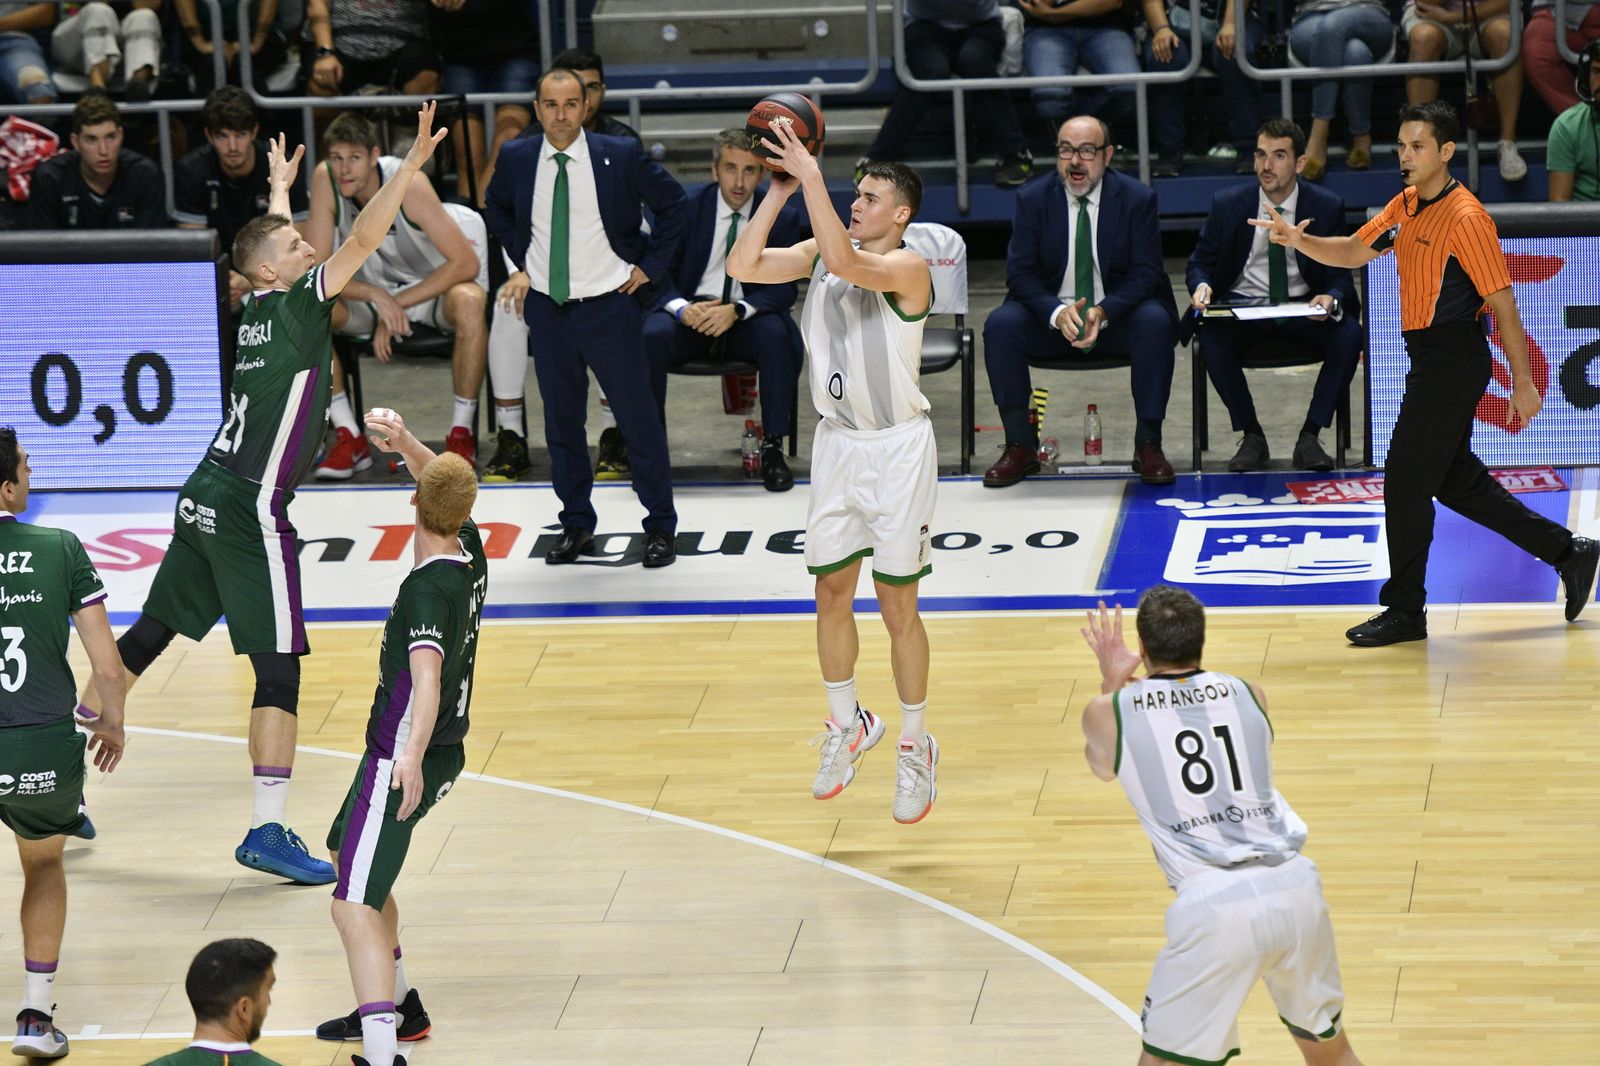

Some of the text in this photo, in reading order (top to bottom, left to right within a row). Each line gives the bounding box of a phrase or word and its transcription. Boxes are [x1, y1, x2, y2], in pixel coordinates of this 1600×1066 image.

[30, 350, 175, 446] 0,0
[828, 372, 843, 400] 0
[409, 622, 444, 640] Andaluc
[0, 626, 28, 693] 3
[1133, 681, 1239, 713] HARANGODY
[1174, 724, 1243, 796] 81
[18, 779, 56, 790] DEL SOL
[20, 770, 57, 783] COSTA
